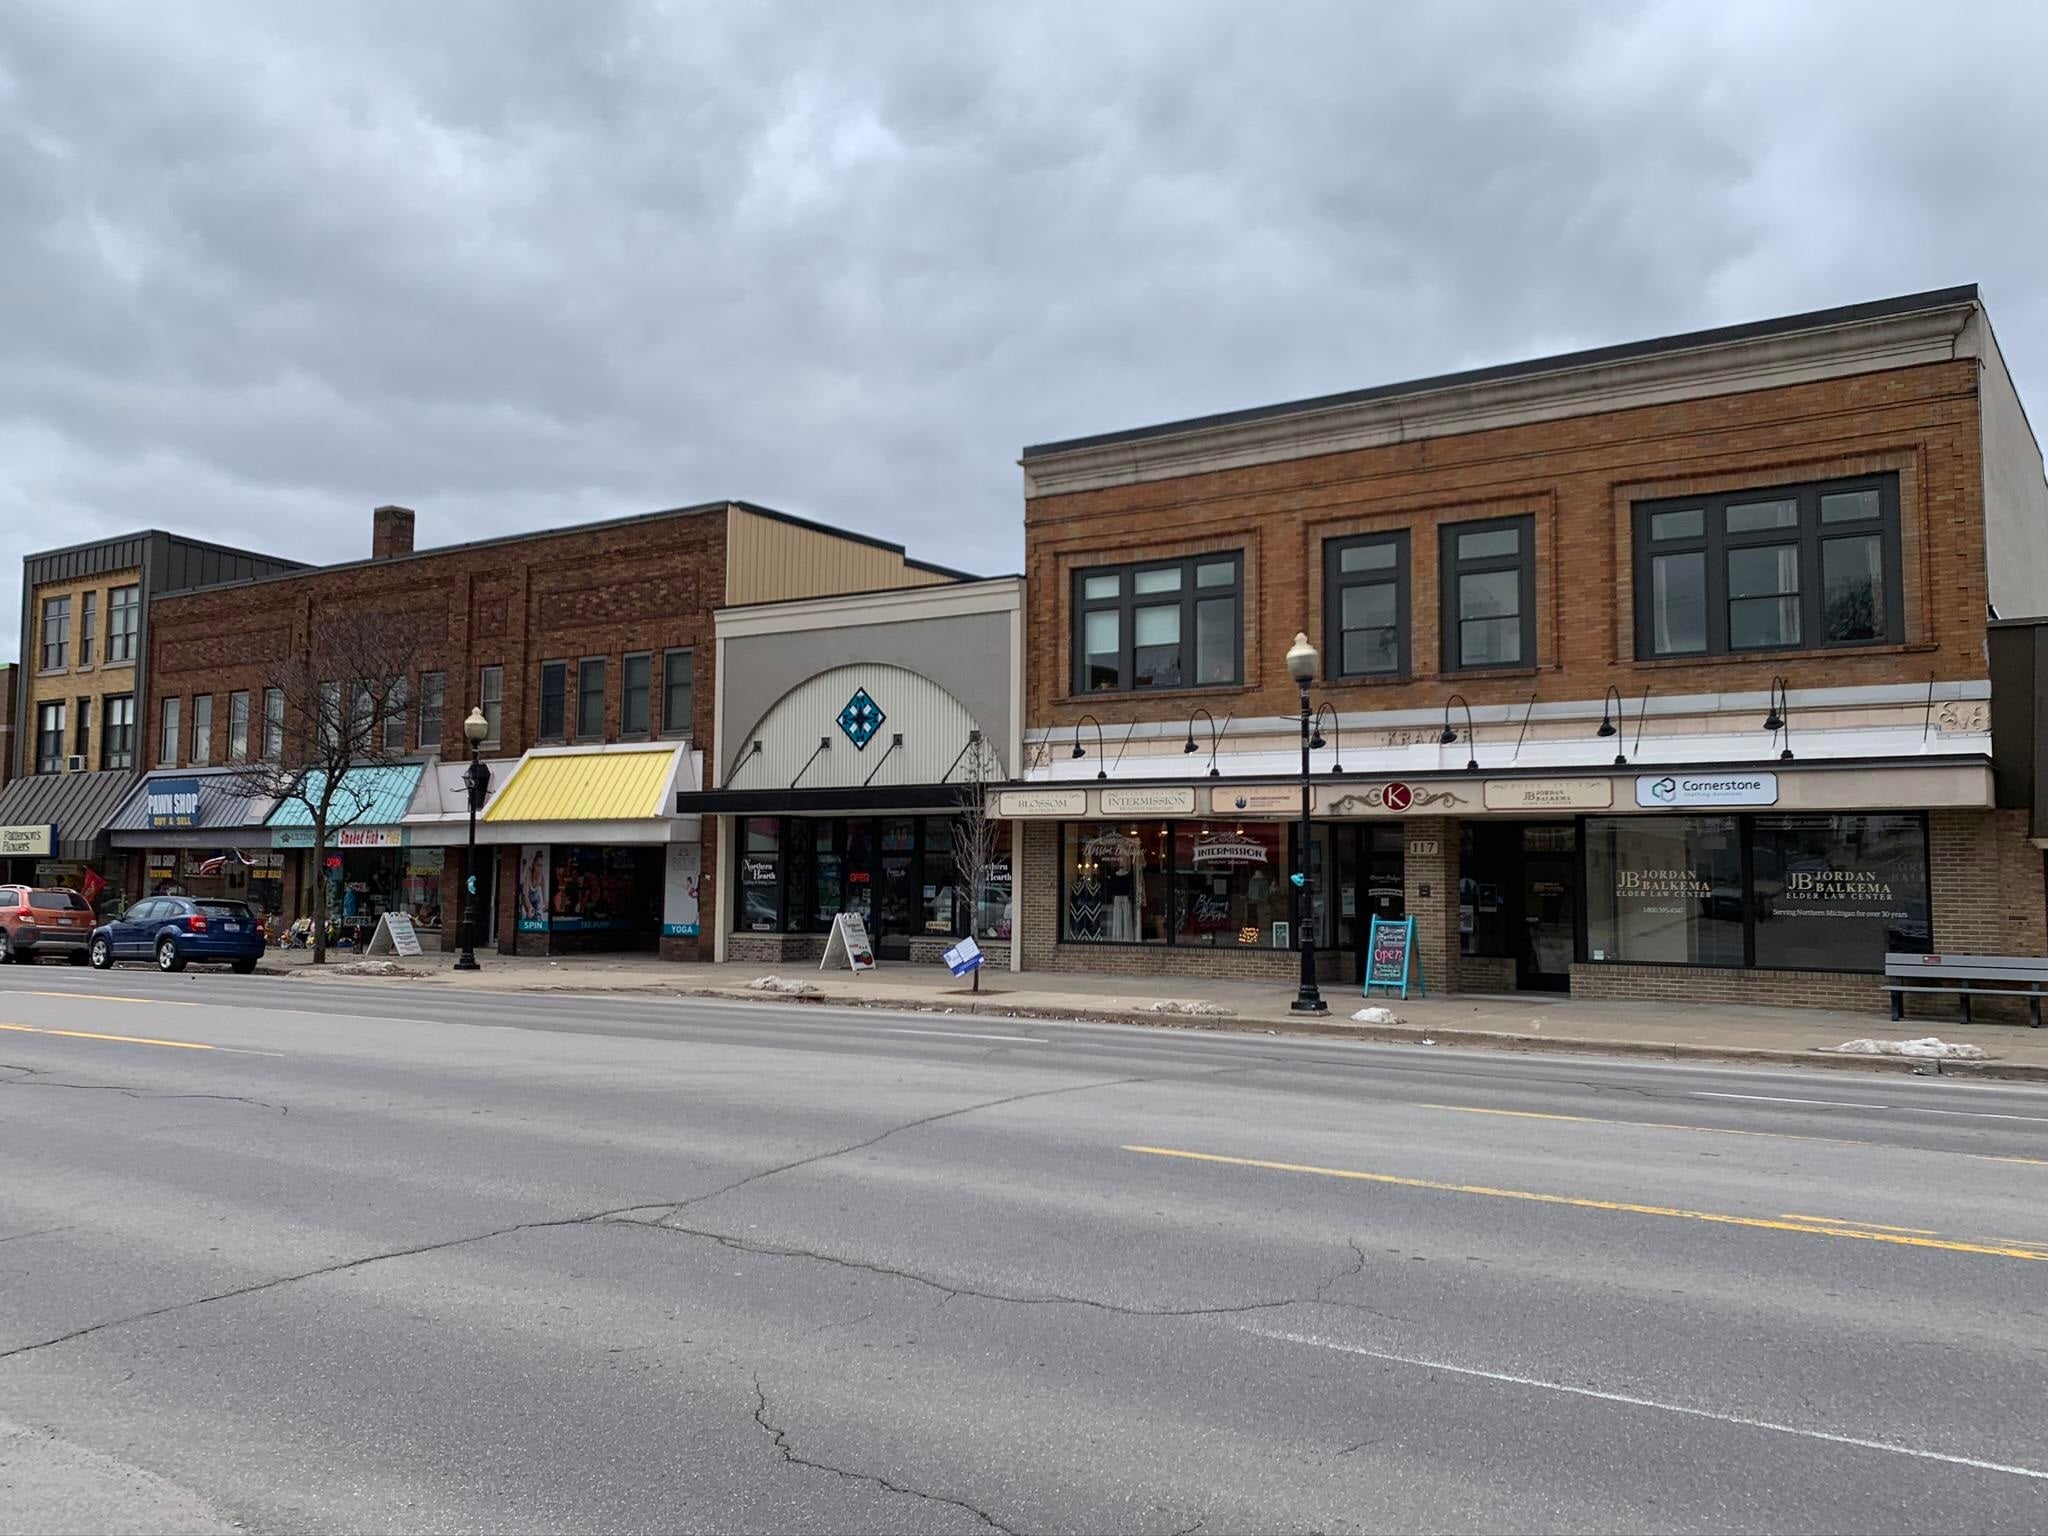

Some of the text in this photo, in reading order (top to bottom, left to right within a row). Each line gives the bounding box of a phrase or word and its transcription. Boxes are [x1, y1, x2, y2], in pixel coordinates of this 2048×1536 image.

[1388, 728, 1473, 745] KRAMR
[1682, 780, 1761, 791] Cornerstone
[1108, 796, 1186, 806] INTERMISSION
[1387, 786, 1406, 807] K
[148, 793, 198, 815] PAWN SHOP
[1018, 799, 1067, 808] BLOSSOM
[176, 816, 192, 825] SELL
[4, 830, 42, 841] Patterson's
[340, 830, 364, 844] Smoked
[365, 830, 379, 844] Fish
[2, 841, 30, 852] Flowers
[1413, 842, 1435, 853] 117
[1198, 847, 1262, 857] INTERMISSION
[743, 859, 773, 872] Northern
[753, 869, 776, 880] Hearth
[850, 873, 870, 882] OPEN
[1641, 869, 1697, 879] JORDAN
[1815, 871, 1876, 881] JORDAN
[1618, 871, 1640, 888] JB
[1788, 872, 1813, 890] JB
[1642, 880, 1710, 890] BALKEMA
[1816, 883, 1891, 893] BALKEMA
[1674, 890, 1712, 898] CENTER
[1851, 893, 1893, 901] CENTER
[1772, 909, 1796, 917] Serving
[1826, 910, 1856, 919] Michigan
[1881, 910, 1890, 918] 30
[1891, 911, 1908, 919] years
[346, 917, 369, 926] GIFTS
[524, 921, 543, 929] SPIN
[671, 925, 693, 934] YOGA
[1374, 948, 1404, 964] Open
